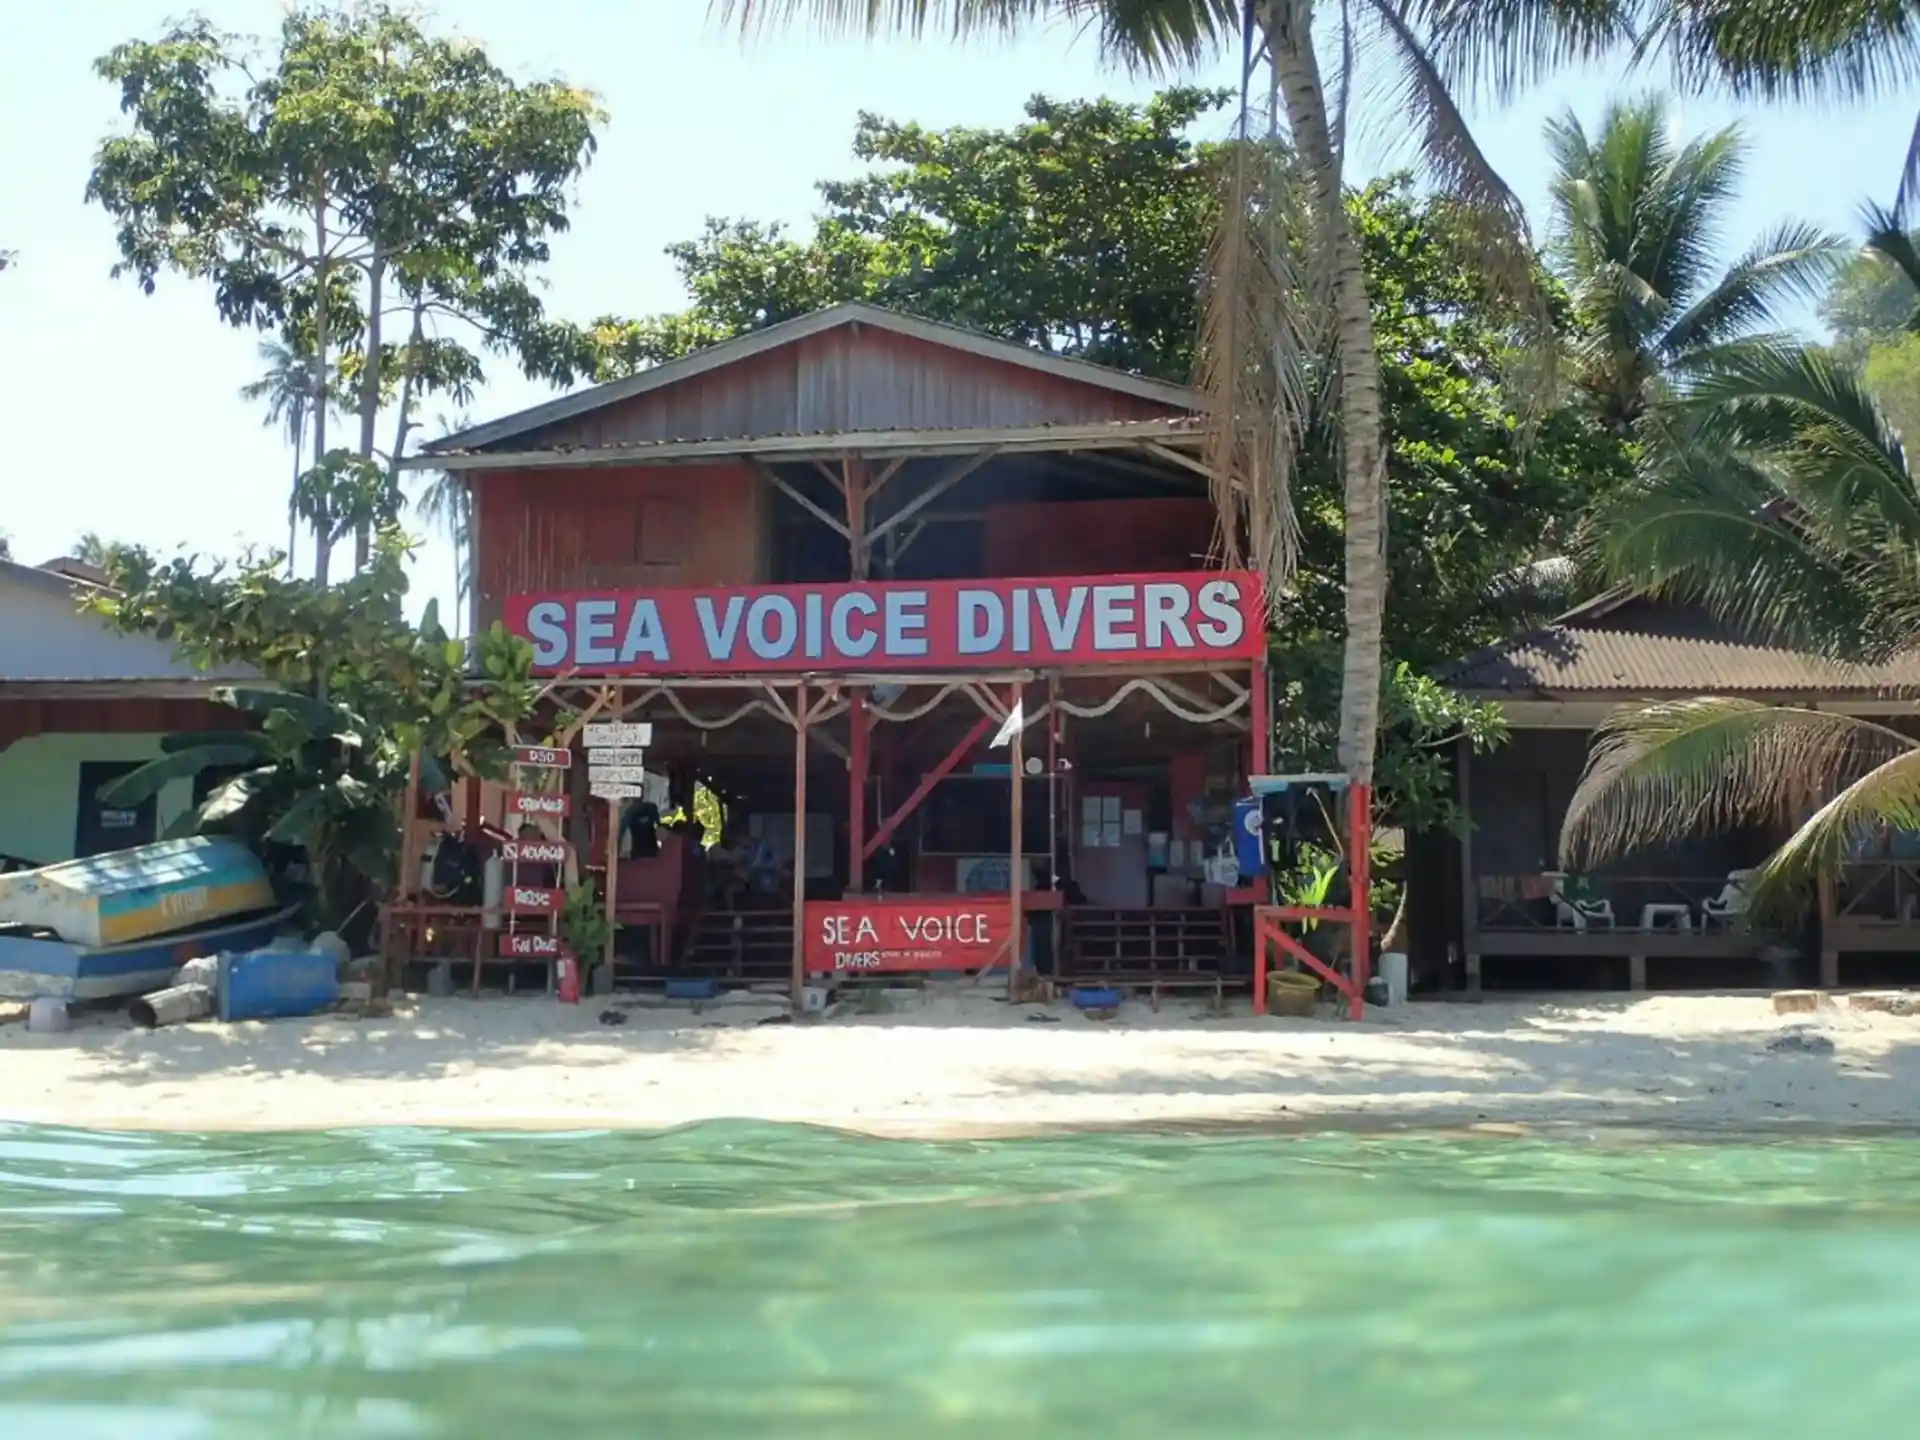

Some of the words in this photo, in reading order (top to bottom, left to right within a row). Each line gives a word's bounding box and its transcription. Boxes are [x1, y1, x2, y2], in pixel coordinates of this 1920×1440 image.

[526, 598, 671, 667] SEA
[693, 590, 928, 661] VOICE
[956, 579, 1244, 655] DIVERS
[822, 915, 880, 945] SEA
[899, 913, 991, 944] VOICE
[834, 950, 881, 970] DIVERS
